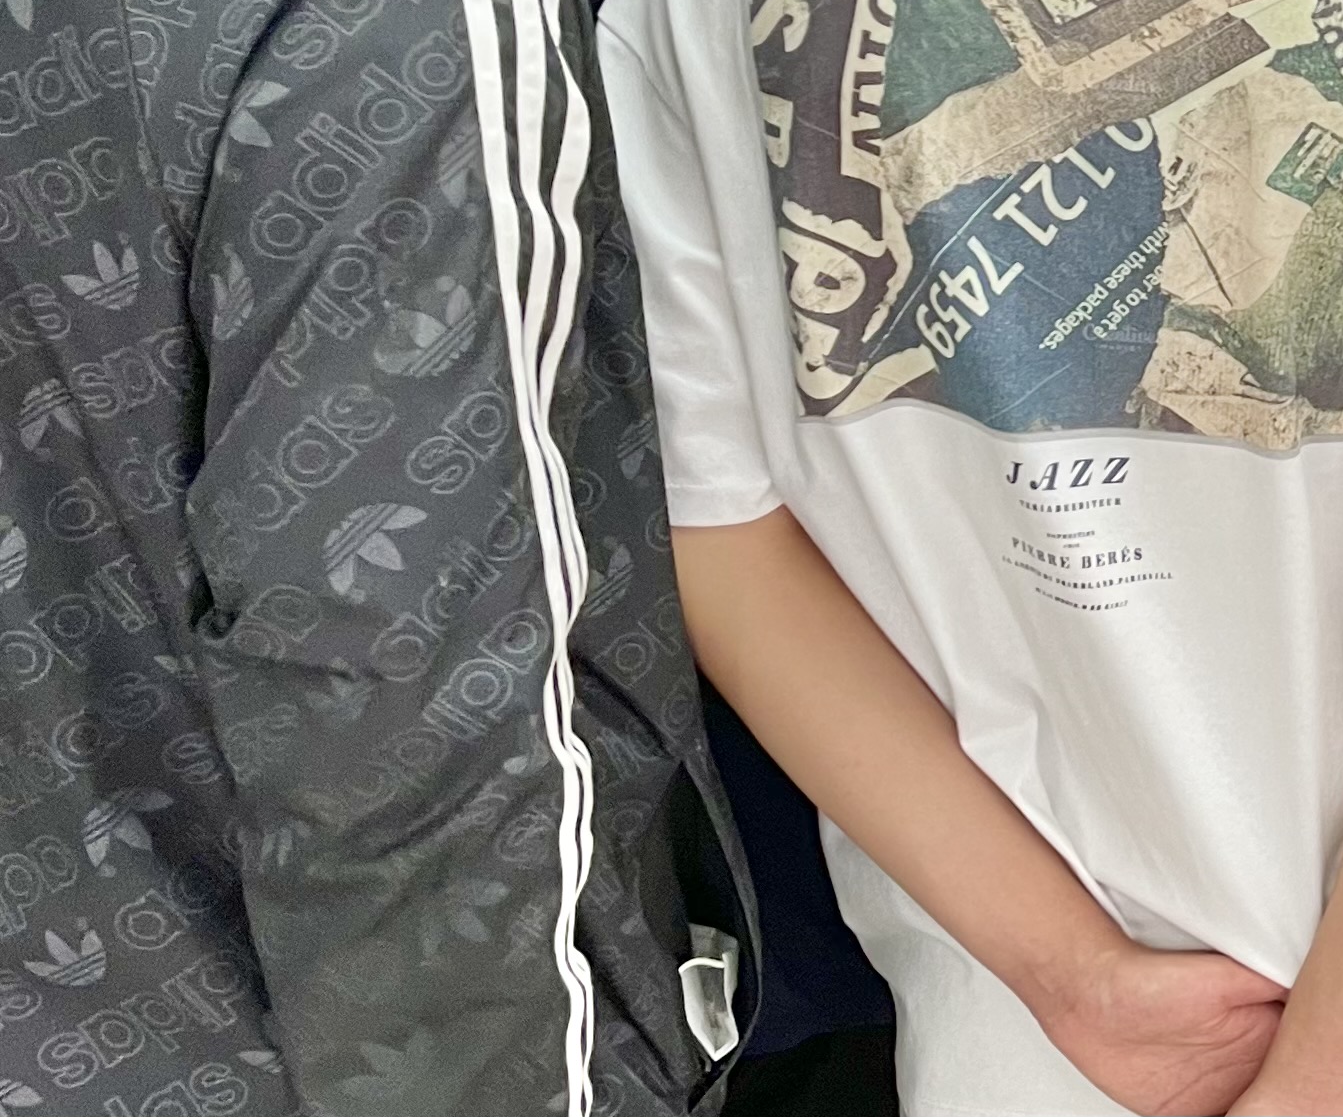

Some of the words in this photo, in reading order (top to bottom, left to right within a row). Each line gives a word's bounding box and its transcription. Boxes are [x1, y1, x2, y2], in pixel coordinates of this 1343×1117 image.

[915, 235, 1025, 359] 7459
[1105, 298, 1131, 331] get
[1005, 456, 1131, 491] JAZZ
